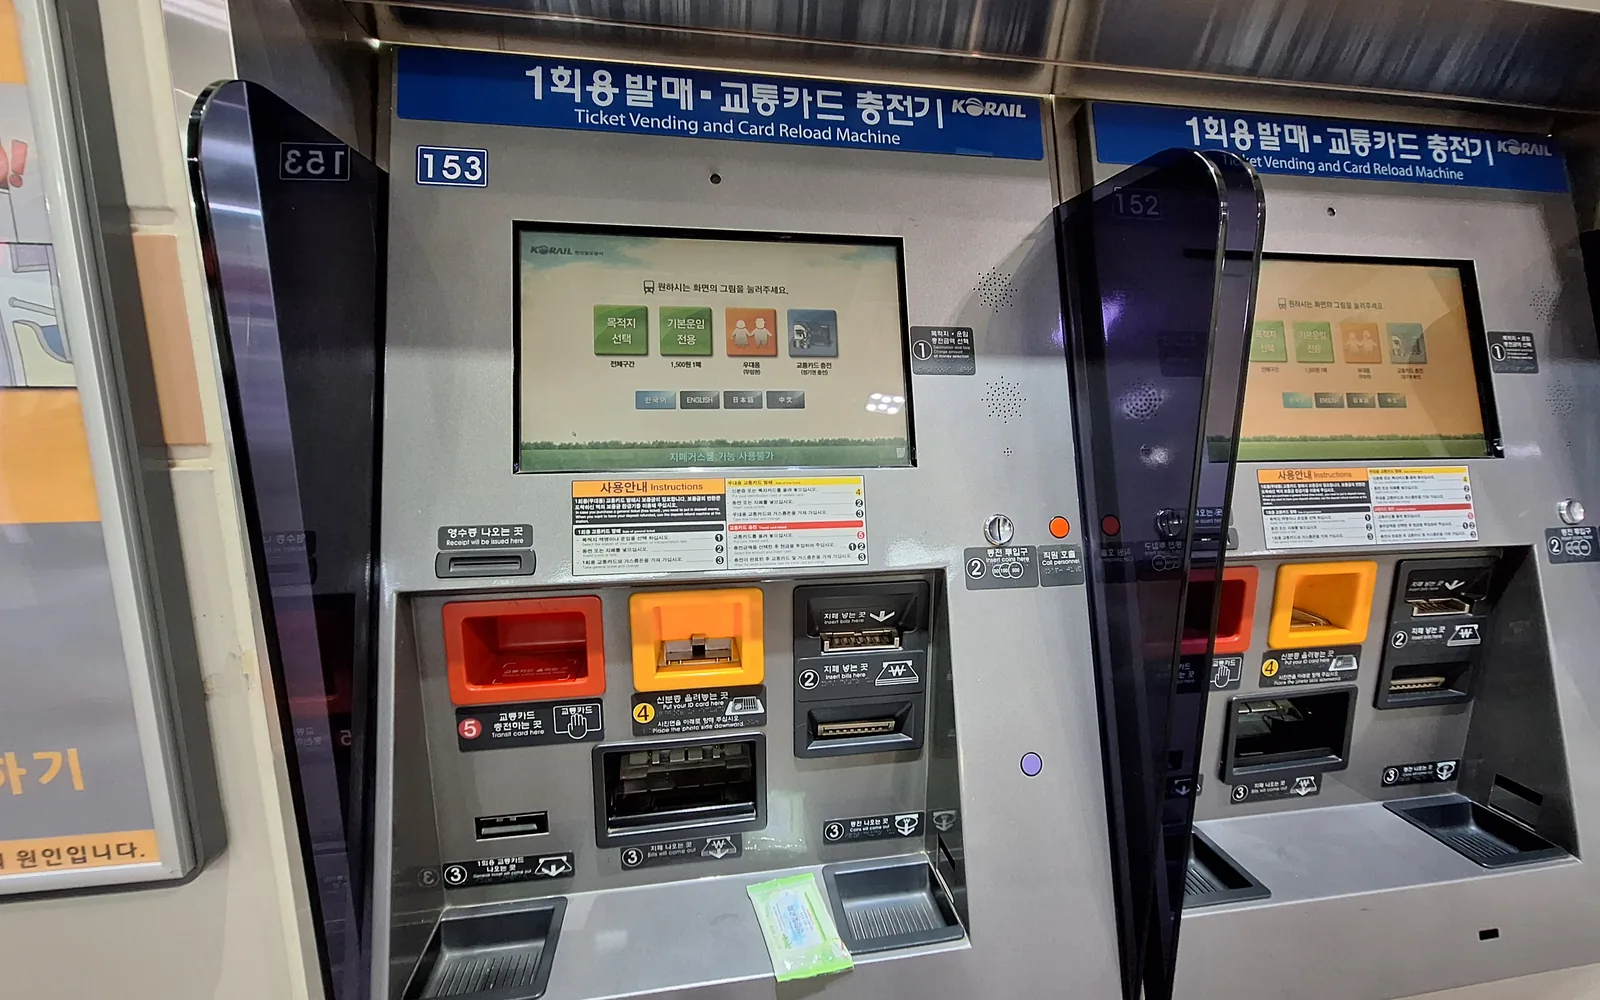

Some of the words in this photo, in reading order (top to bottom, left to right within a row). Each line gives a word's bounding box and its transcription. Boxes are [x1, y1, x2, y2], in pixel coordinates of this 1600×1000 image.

[856, 89, 943, 128] 충전기
[952, 98, 1026, 118] KORAIL
[574, 109, 625, 126] Ticket
[629, 113, 698, 134] Vending
[703, 120, 733, 134] and
[738, 121, 774, 136] Card
[780, 124, 832, 140] Reload
[837, 128, 900, 144] Machine
[1427, 134, 1493, 165] 충전기
[1497, 139, 1552, 156] KORAIL
[422, 154, 483, 180] 153
[1264, 156, 1315, 173] Vending
[1318, 161, 1340, 172] and
[1343, 161, 1371, 174] Card
[1374, 163, 1413, 177] Reload
[1416, 166, 1464, 180] Machine
[1116, 194, 1158, 215] 152
[530, 245, 573, 255] KORAIL
[658, 283, 690, 292] 원하시는
[693, 284, 717, 292] 화면의
[720, 285, 744, 293] 그림을
[607, 318, 635, 328] 목적지
[668, 319, 704, 329] 기본운임
[612, 334, 631, 344] 선택
[677, 335, 696, 345] 전용
[1278, 470, 1312, 480] 사용안내
[601, 482, 647, 493] 사용안내
[651, 482, 703, 491] Instructions
[448, 528, 477, 538] 영수증
[481, 527, 510, 537] 나오는
[514, 527, 523, 536] 곳
[824, 612, 838, 620] 지폐
[1395, 633, 1404, 645] 2
[824, 665, 839, 673] 지폐
[861, 663, 868, 671] 곳
[1265, 661, 1274, 674] 4
[804, 672, 814, 686] 2
[657, 695, 681, 704] 신분증
[499, 711, 535, 721] 교통카드
[638, 705, 649, 720] 4
[464, 721, 476, 736] 5
[494, 722, 529, 731] 충전하는
[1387, 770, 1394, 781] 3
[1236, 787, 1244, 798] 3
[16, 842, 145, 868] 원인입니다.
[628, 851, 637, 863] 3
[451, 868, 462, 882] 3
